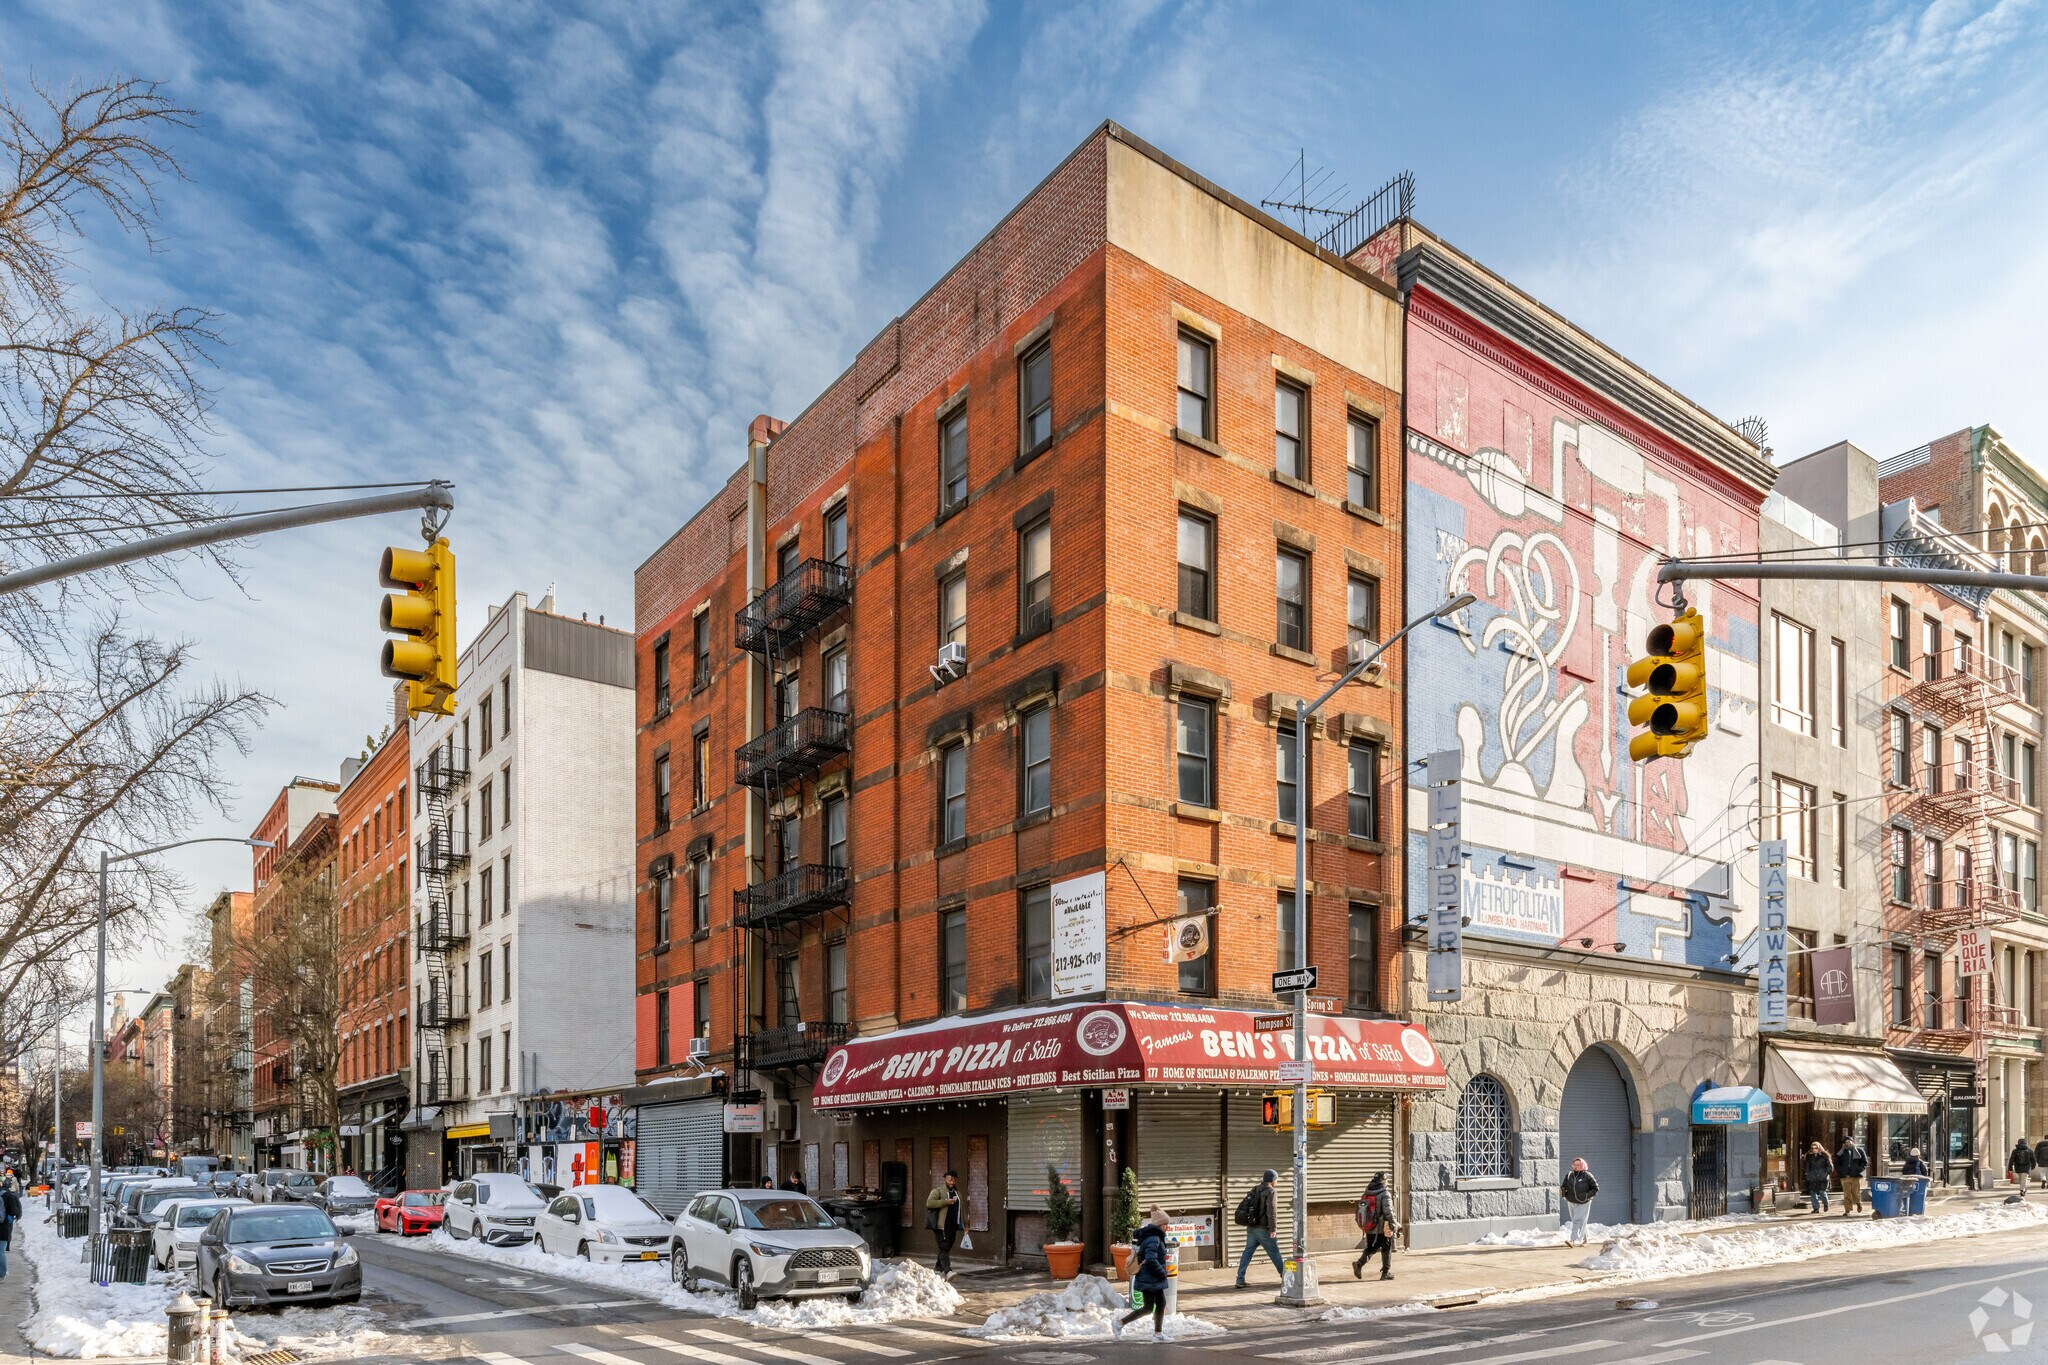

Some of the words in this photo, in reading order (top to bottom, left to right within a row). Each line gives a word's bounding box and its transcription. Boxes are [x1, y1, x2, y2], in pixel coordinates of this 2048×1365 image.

[1436, 790, 1459, 955] LUMBER
[1463, 879, 1560, 935] METROPOLITAN
[1481, 913, 1504, 927] LUMBER
[1505, 917, 1517, 929] AND
[1520, 920, 1549, 934] HARDWARE
[1767, 847, 1785, 1018] HARDWARE
[1961, 932, 1977, 946] BO
[1962, 943, 1986, 960] QUE
[1963, 957, 1987, 973] RIA
[1278, 977, 1291, 987] ONE
[1297, 974, 1311, 984] WAY
[1307, 999, 1326, 1013] Spring
[1327, 1000, 1334, 1011] St
[1128, 1010, 1141, 1019] We
[1141, 1010, 1168, 1021] Deliver
[1255, 1019, 1284, 1030] Thompson
[1285, 1016, 1293, 1027] St
[1002, 1023, 1011, 1033] We
[1011, 1021, 1032, 1032] Deliver
[1141, 1030, 1194, 1056] Famous
[1200, 1029, 1276, 1060] BEN'S
[1359, 1042, 1372, 1060] of
[1372, 1043, 1403, 1062] SoHo
[845, 1057, 885, 1085] Famous
[881, 1049, 944, 1081] BEN'S
[942, 1039, 1012, 1075] PIZZA
[1012, 1041, 1030, 1063] of
[1028, 1038, 1062, 1061] SoHo
[1062, 1070, 1081, 1082] Best
[1083, 1069, 1115, 1081] Sicilian
[1117, 1067, 1140, 1079] Pizza
[1147, 1067, 1158, 1078] 177
[1163, 1067, 1185, 1078] HOME
[1186, 1067, 1196, 1079] OF
[1196, 1068, 1229, 1079] SICILIAN
[1229, 1068, 1236, 1079] &
[1236, 1069, 1269, 1080] PALERMO
[1334, 1072, 1369, 1083] HOMEMADE
[1369, 1073, 1394, 1084] ITALIAN
[1394, 1074, 1407, 1085] ICES
[1412, 1075, 1424, 1085] HOT
[1424, 1075, 1446, 1086] HEROES
[821, 1095, 833, 1105] HOME
[833, 1094, 840, 1104] OF
[840, 1092, 861, 1104] SICILIAN
[866, 1090, 888, 1101] PALERMO
[888, 1089, 903, 1099] PIZZA
[907, 1085, 935, 1097] CALZONES
[940, 1082, 971, 1094] HOMEMADE
[971, 1079, 996, 1091] ITALIAN
[997, 1077, 1012, 1088] ICES
[1017, 1075, 1031, 1087] HOT
[1031, 1071, 1057, 1085] HEROES
[1704, 1109, 1740, 1119] METROPOLITAN
[345, 1126, 353, 1134] A
